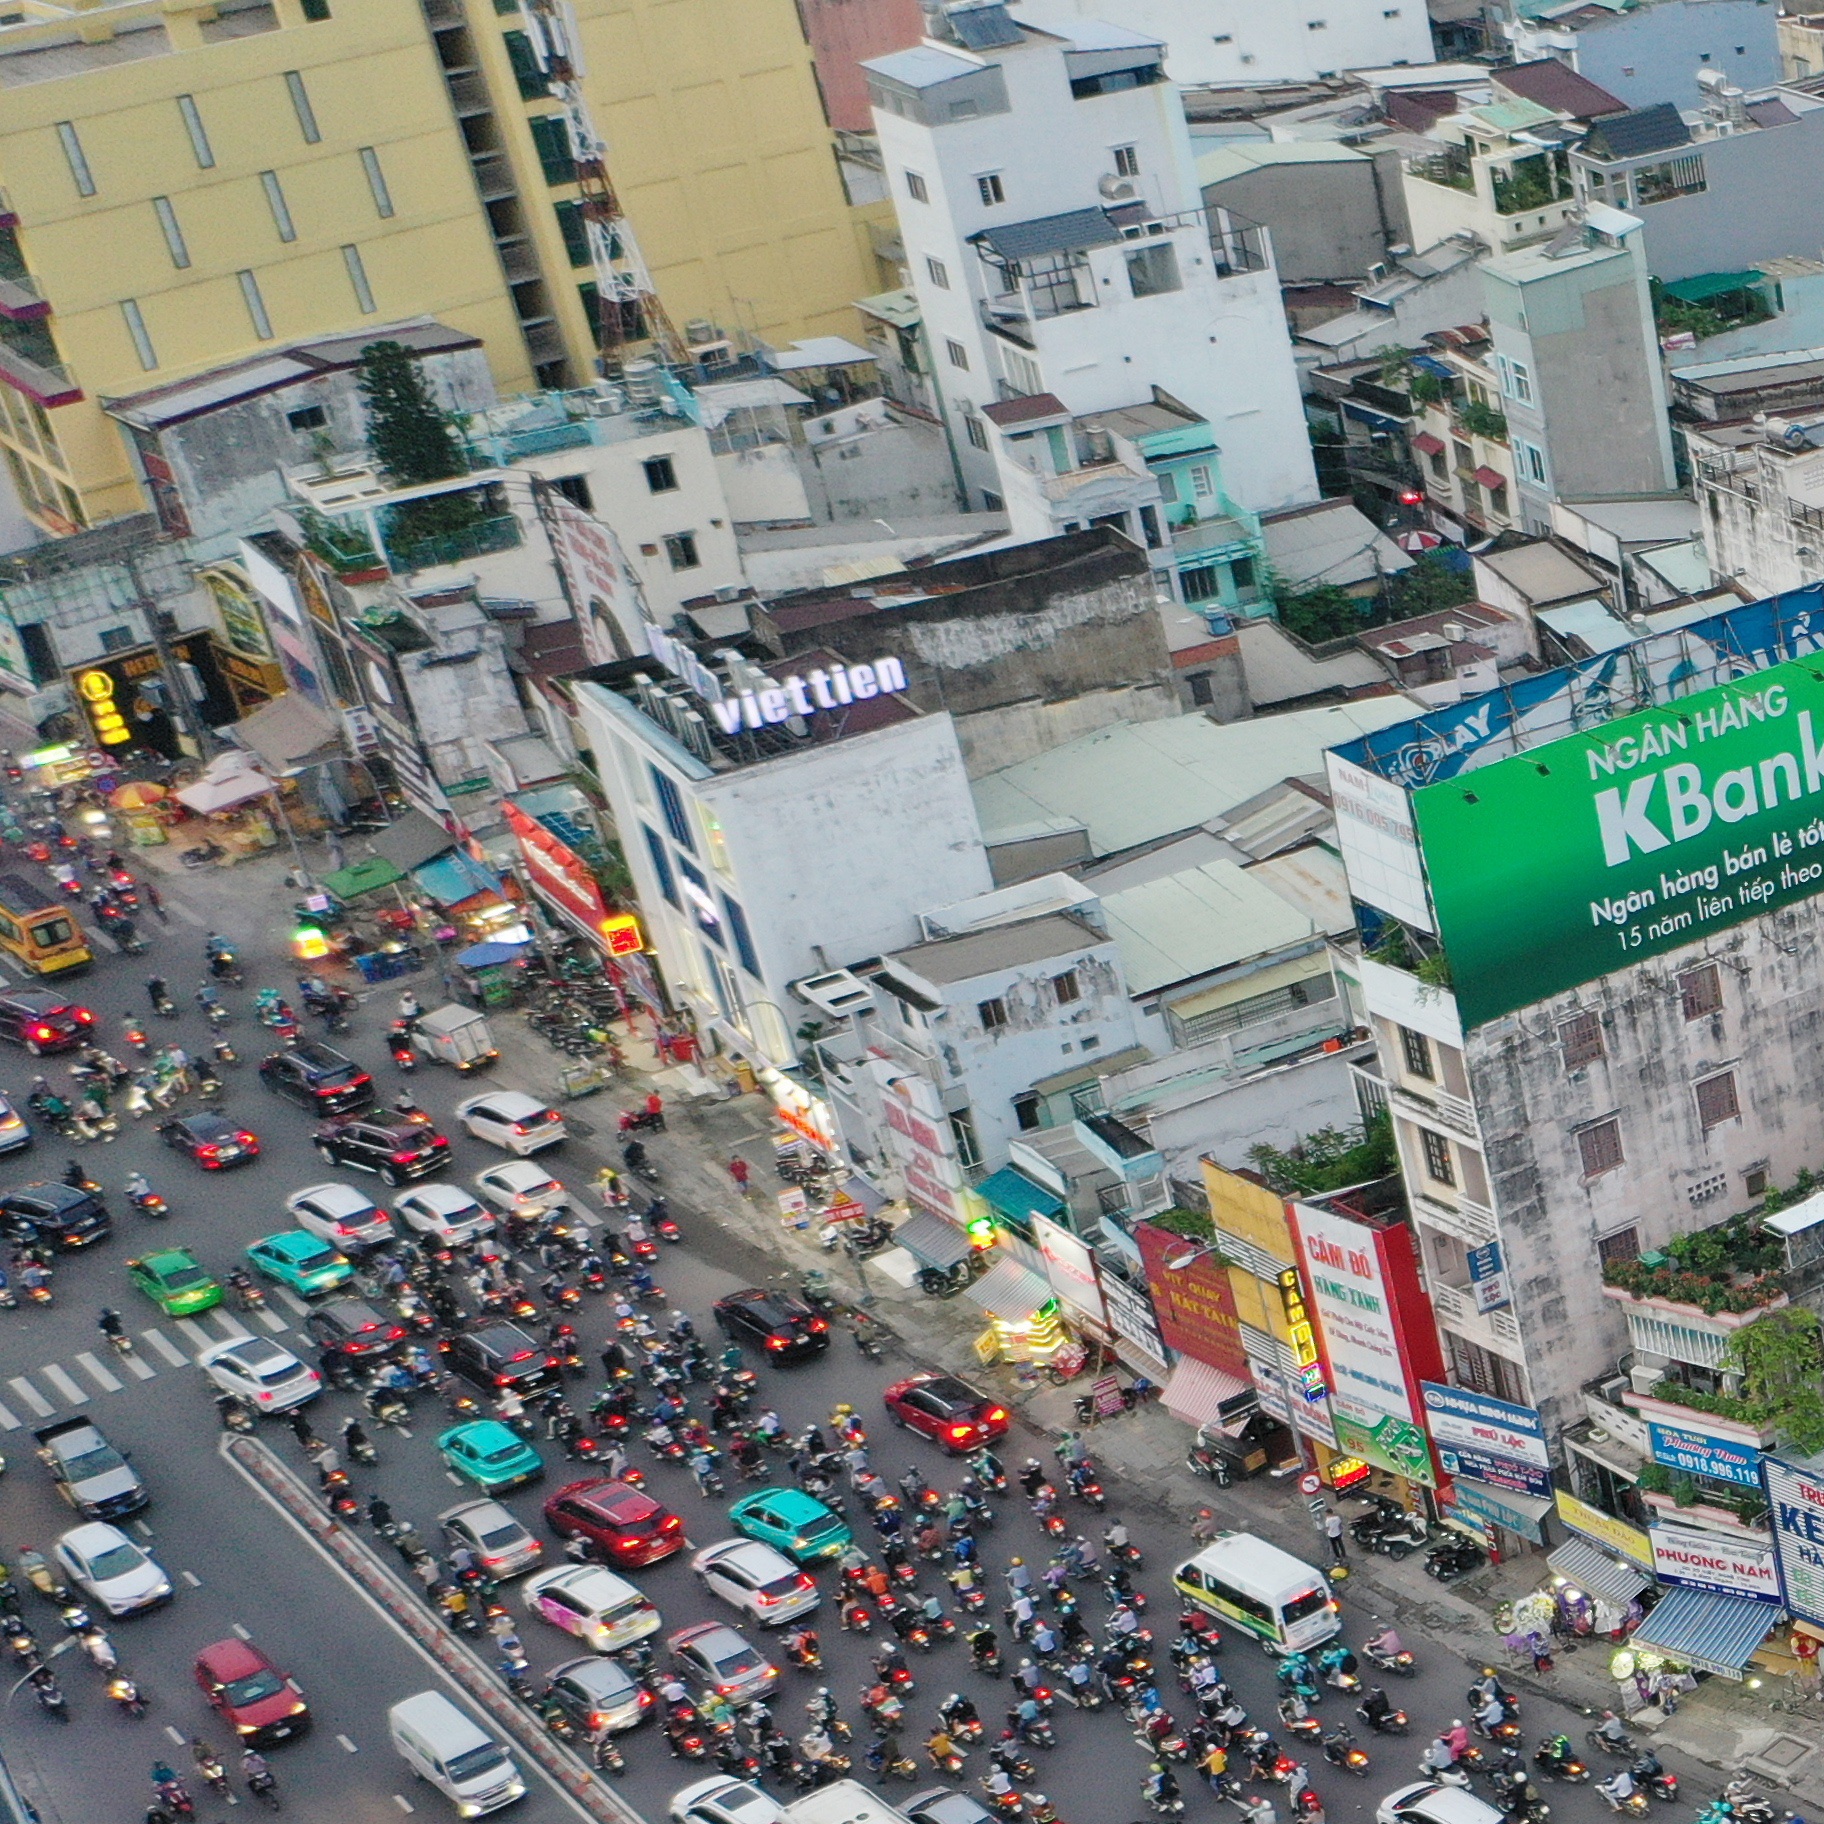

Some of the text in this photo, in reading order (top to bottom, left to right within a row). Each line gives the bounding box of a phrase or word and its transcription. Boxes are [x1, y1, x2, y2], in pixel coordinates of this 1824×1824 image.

[712, 656, 907, 735] viettien
[1586, 685, 1788, 781] NGÂN HÀNG
[1590, 889, 1656, 927] Ngân
[1661, 865, 1720, 900] hàng
[1724, 846, 1767, 877] bán
[1773, 831, 1794, 859] lẻ
[1617, 929, 1644, 952] 15
[1648, 909, 1693, 941] năm
[1698, 895, 1734, 922] liên
[1738, 876, 1776, 907] tiếp
[1781, 863, 1822, 892] theo
[1307, 1231, 1373, 1280] CẦM ĐỒ
[1314, 1274, 1382, 1317] HÀNG XANH
[1678, 1452, 1759, 1485] 0918.996.119
[1733, 1563, 1772, 1580] NAM
